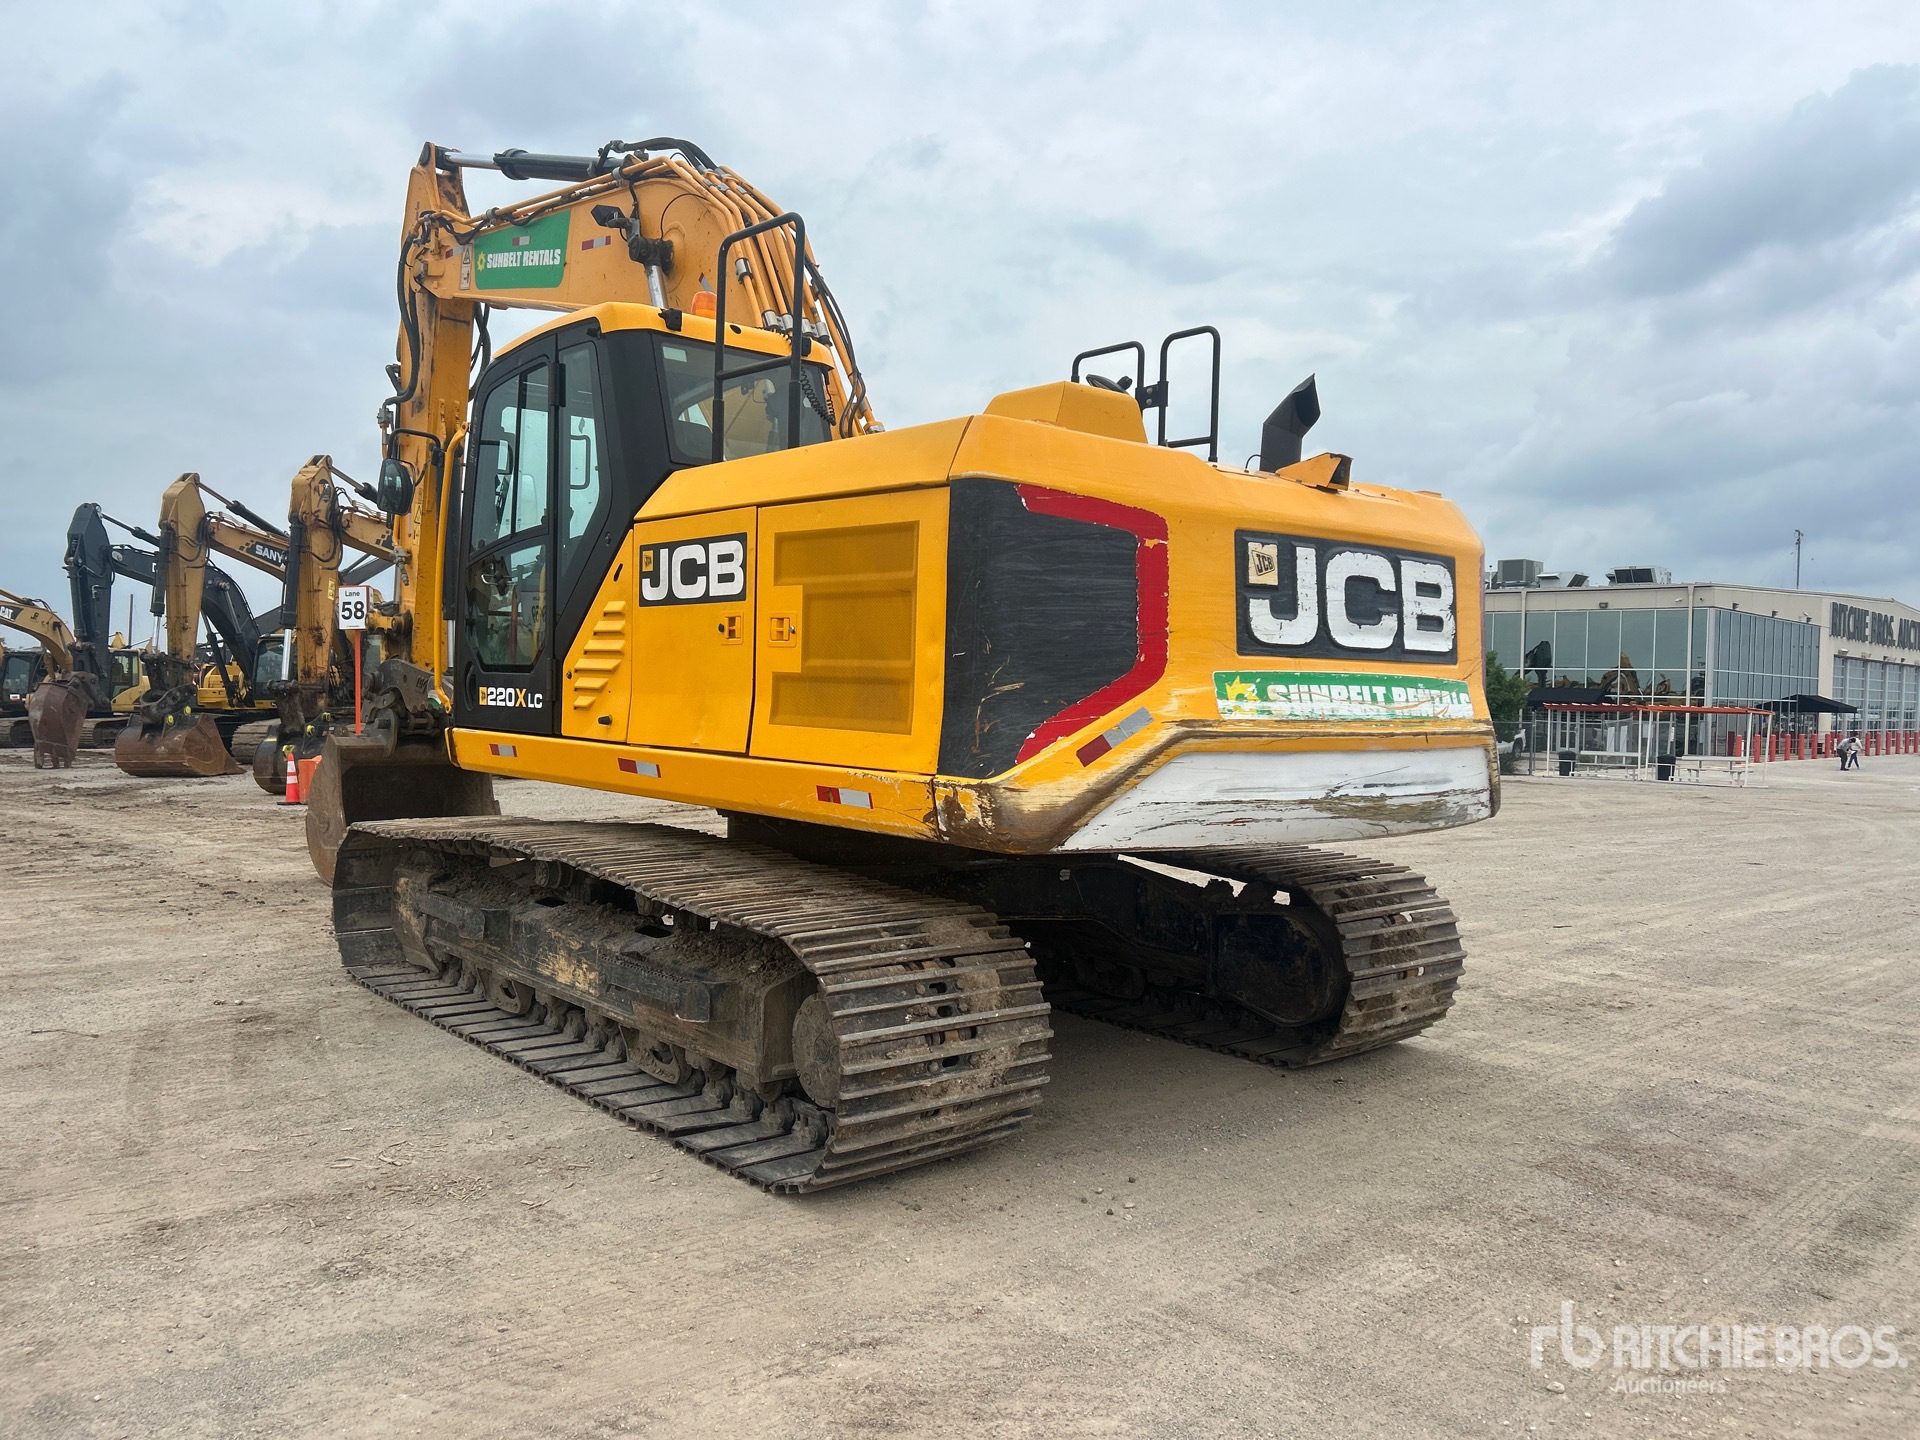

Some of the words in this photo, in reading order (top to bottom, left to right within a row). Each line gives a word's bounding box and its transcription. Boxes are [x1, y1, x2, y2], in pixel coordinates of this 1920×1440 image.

[486, 251, 522, 269] SUNBELT
[523, 248, 562, 267] RENTALS
[255, 544, 285, 563] SANY
[1256, 553, 1274, 574] JCB
[642, 540, 744, 601] JCB
[1248, 546, 1456, 652] JCB
[0, 606, 14, 620] CAT
[341, 601, 365, 620] 58
[1829, 602, 1869, 643] RITCHIE
